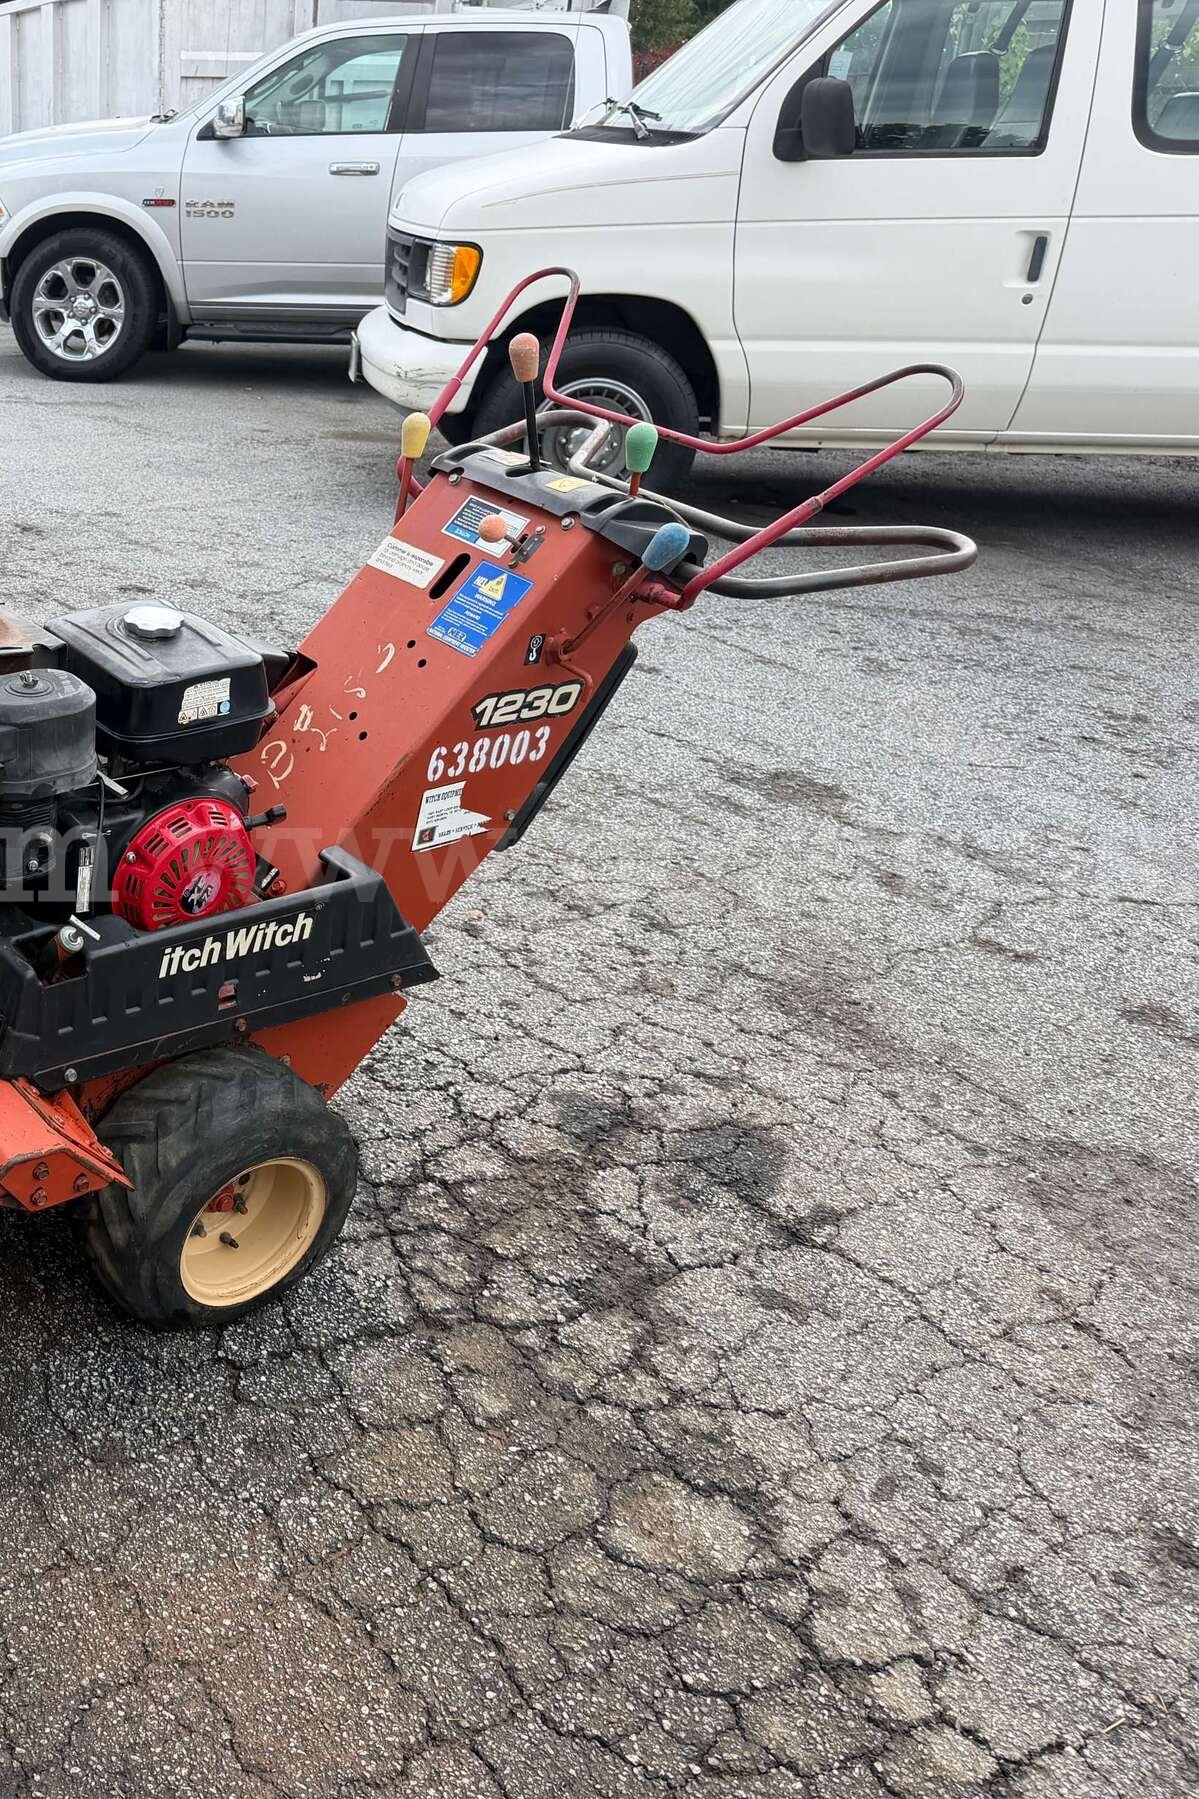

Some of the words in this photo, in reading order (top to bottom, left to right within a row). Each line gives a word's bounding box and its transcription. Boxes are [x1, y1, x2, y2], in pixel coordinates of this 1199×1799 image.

[185, 200, 235, 208] RAM
[185, 209, 235, 218] 1500
[476, 684, 581, 726] 1230
[427, 726, 550, 783] 638003
[225, 912, 314, 960] Witch
